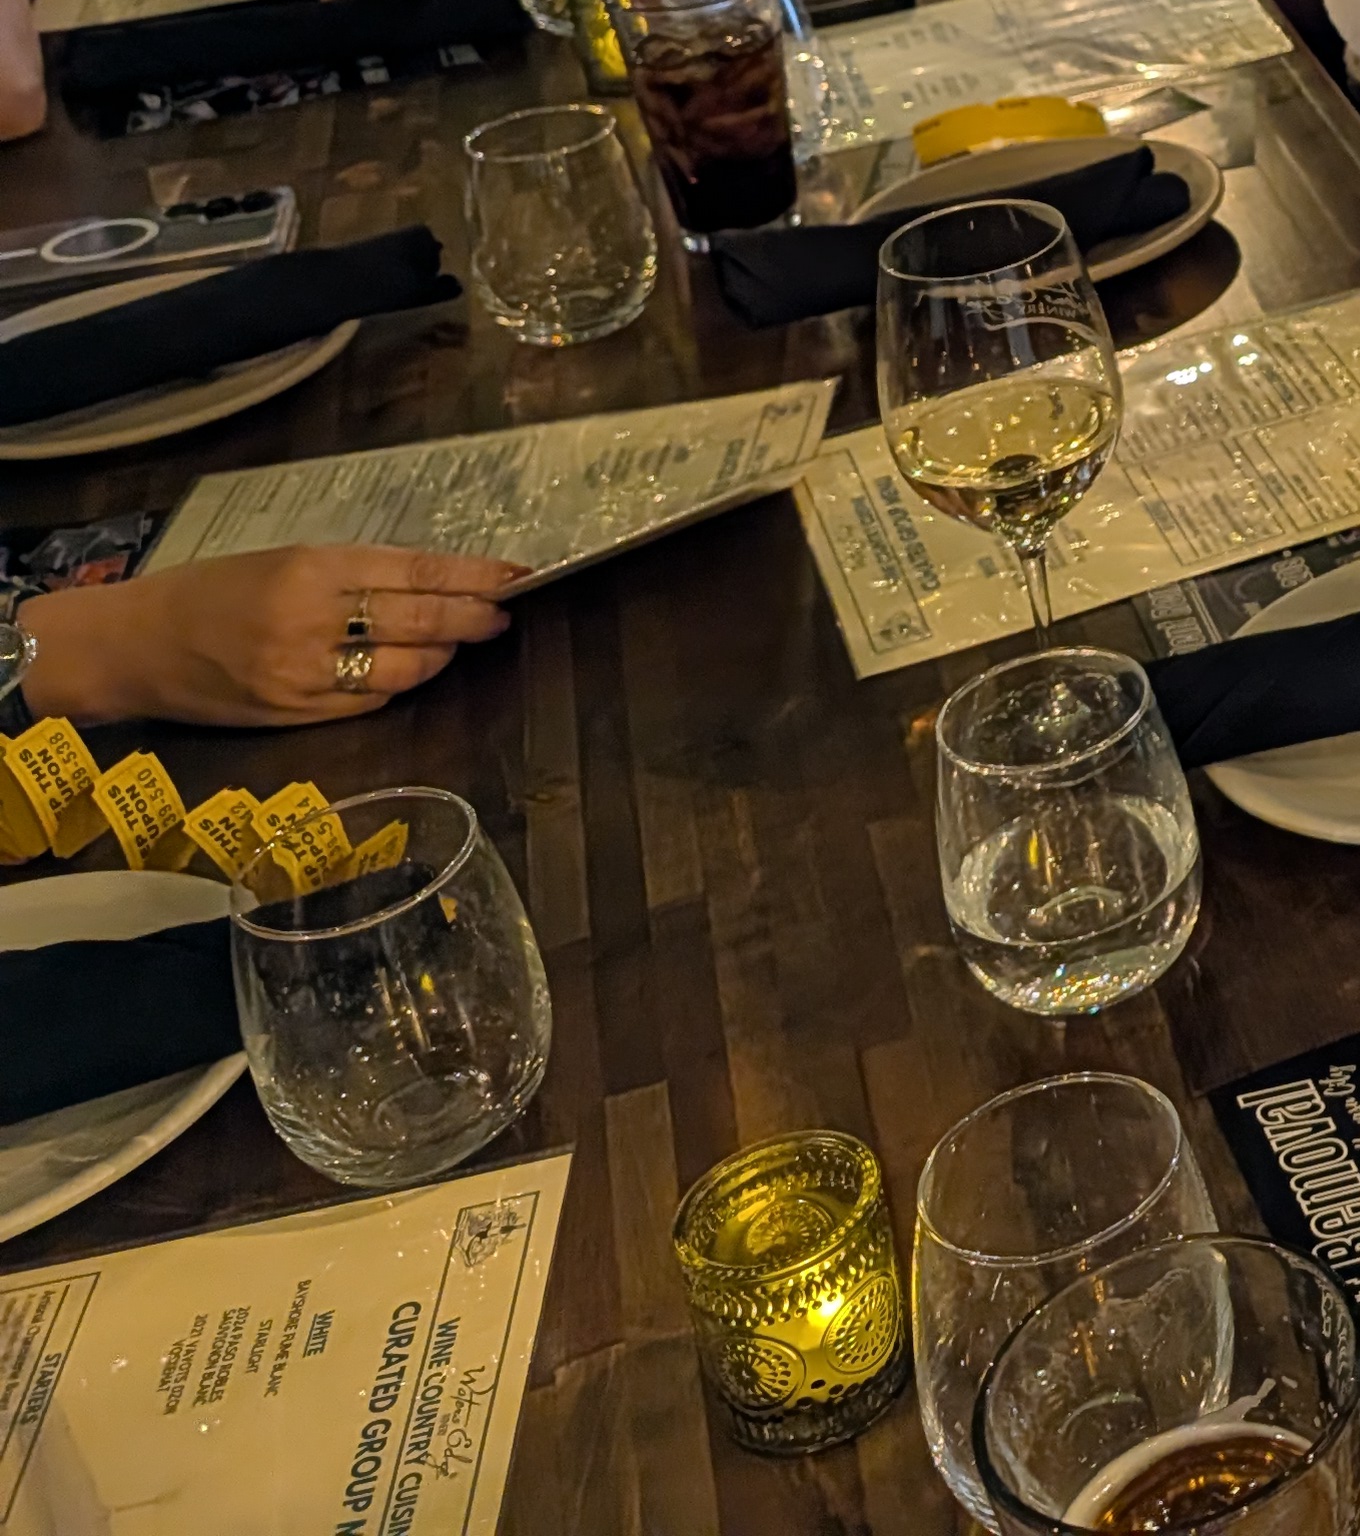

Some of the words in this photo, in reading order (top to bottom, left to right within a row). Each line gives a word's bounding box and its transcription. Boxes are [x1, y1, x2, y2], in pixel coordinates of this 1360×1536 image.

[17, 746, 54, 795] THIS
[35, 746, 76, 802] UPON
[46, 729, 93, 791] 39-538
[105, 782, 141, 831] THIS
[122, 783, 163, 840] UPON
[134, 766, 180, 828] 39-540
[197, 815, 239, 858] THIS
[284, 811, 329, 868] UPON
[1318, 1064, 1357, 1097] City
[230, 1305, 251, 1332] 2024
[305, 1309, 335, 1357] WHITE
[427, 1316, 461, 1369] WINE
[220, 1333, 243, 1362] PASO
[244, 1319, 274, 1374] STARLIGHT
[367, 1301, 423, 1413] CURATED
[19, 1353, 62, 1424] STARTERS
[262, 1361, 287, 1398] BLANC
[403, 1371, 447, 1466] COUNTRY
[339, 1418, 393, 1512] GROUP
